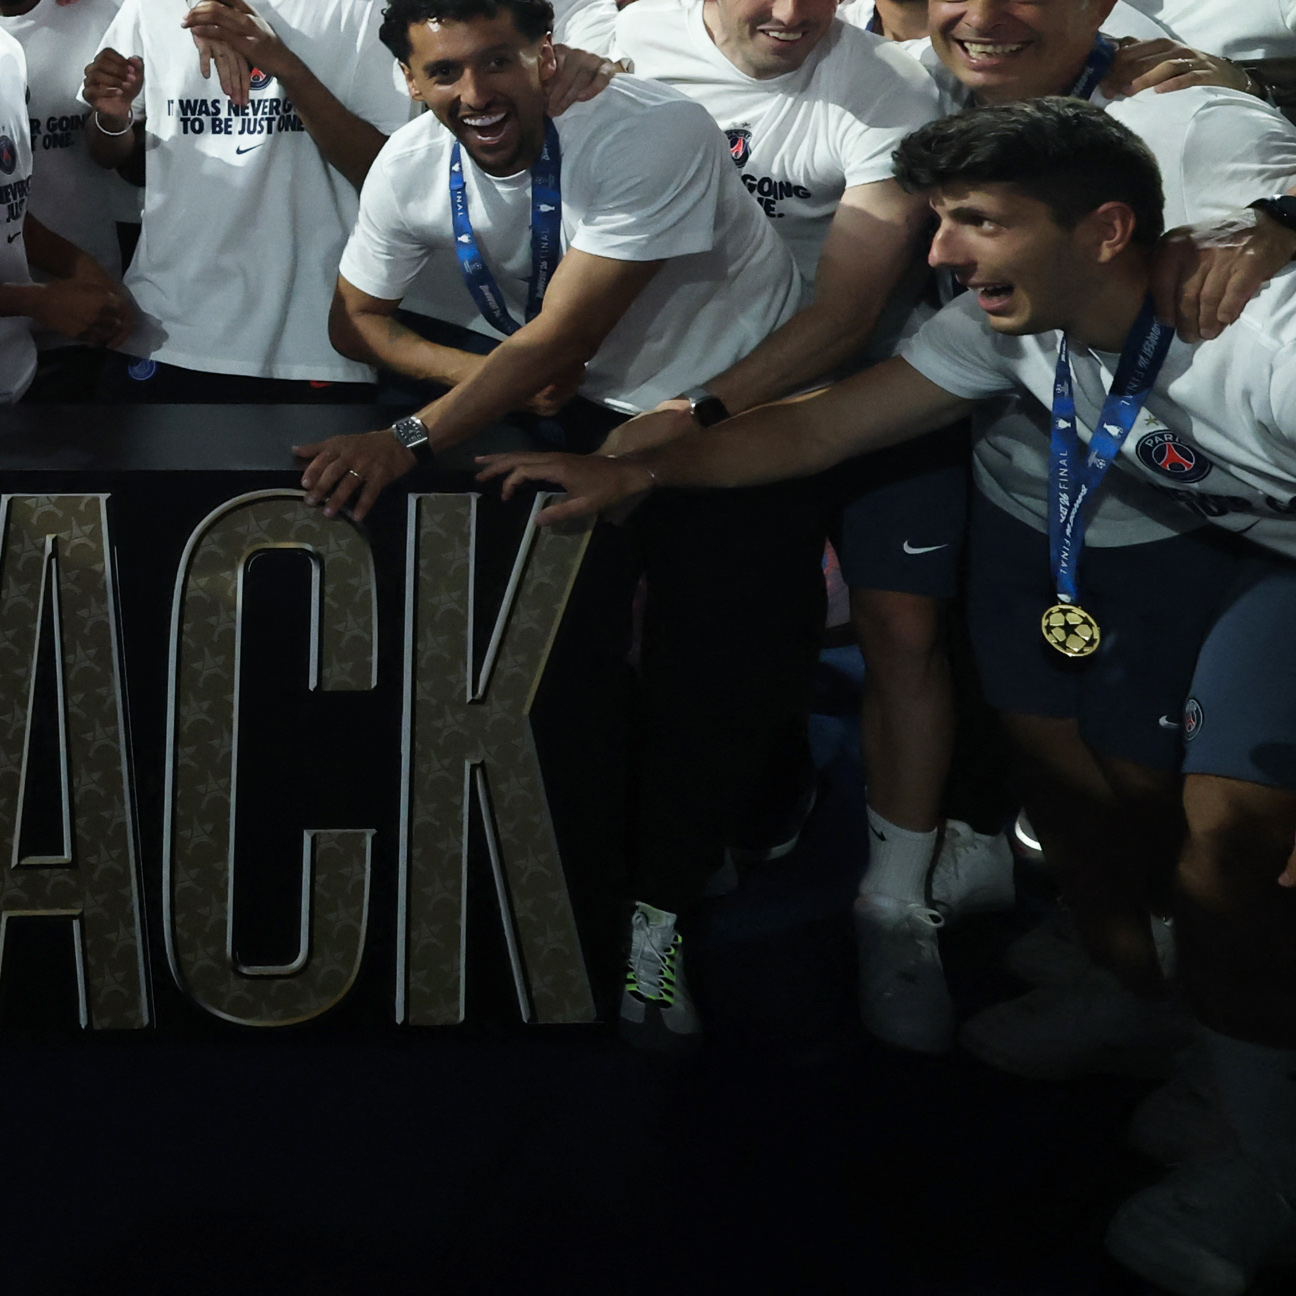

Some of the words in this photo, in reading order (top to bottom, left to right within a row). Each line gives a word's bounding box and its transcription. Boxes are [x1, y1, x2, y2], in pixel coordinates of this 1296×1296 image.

[179, 99, 221, 117] WAS
[227, 99, 281, 117] NEVER
[46, 114, 87, 134] GOIN
[180, 116, 205, 135] TO
[211, 116, 233, 135] BE
[238, 116, 276, 135] JUST
[741, 173, 812, 200] GOING
[540, 228, 550, 259] FINAL
[1121, 370, 1146, 406] FINAL
[1145, 433, 1183, 448] PARI
[1058, 449, 1068, 492] FINAL
[1059, 539, 1072, 575] FINAL
